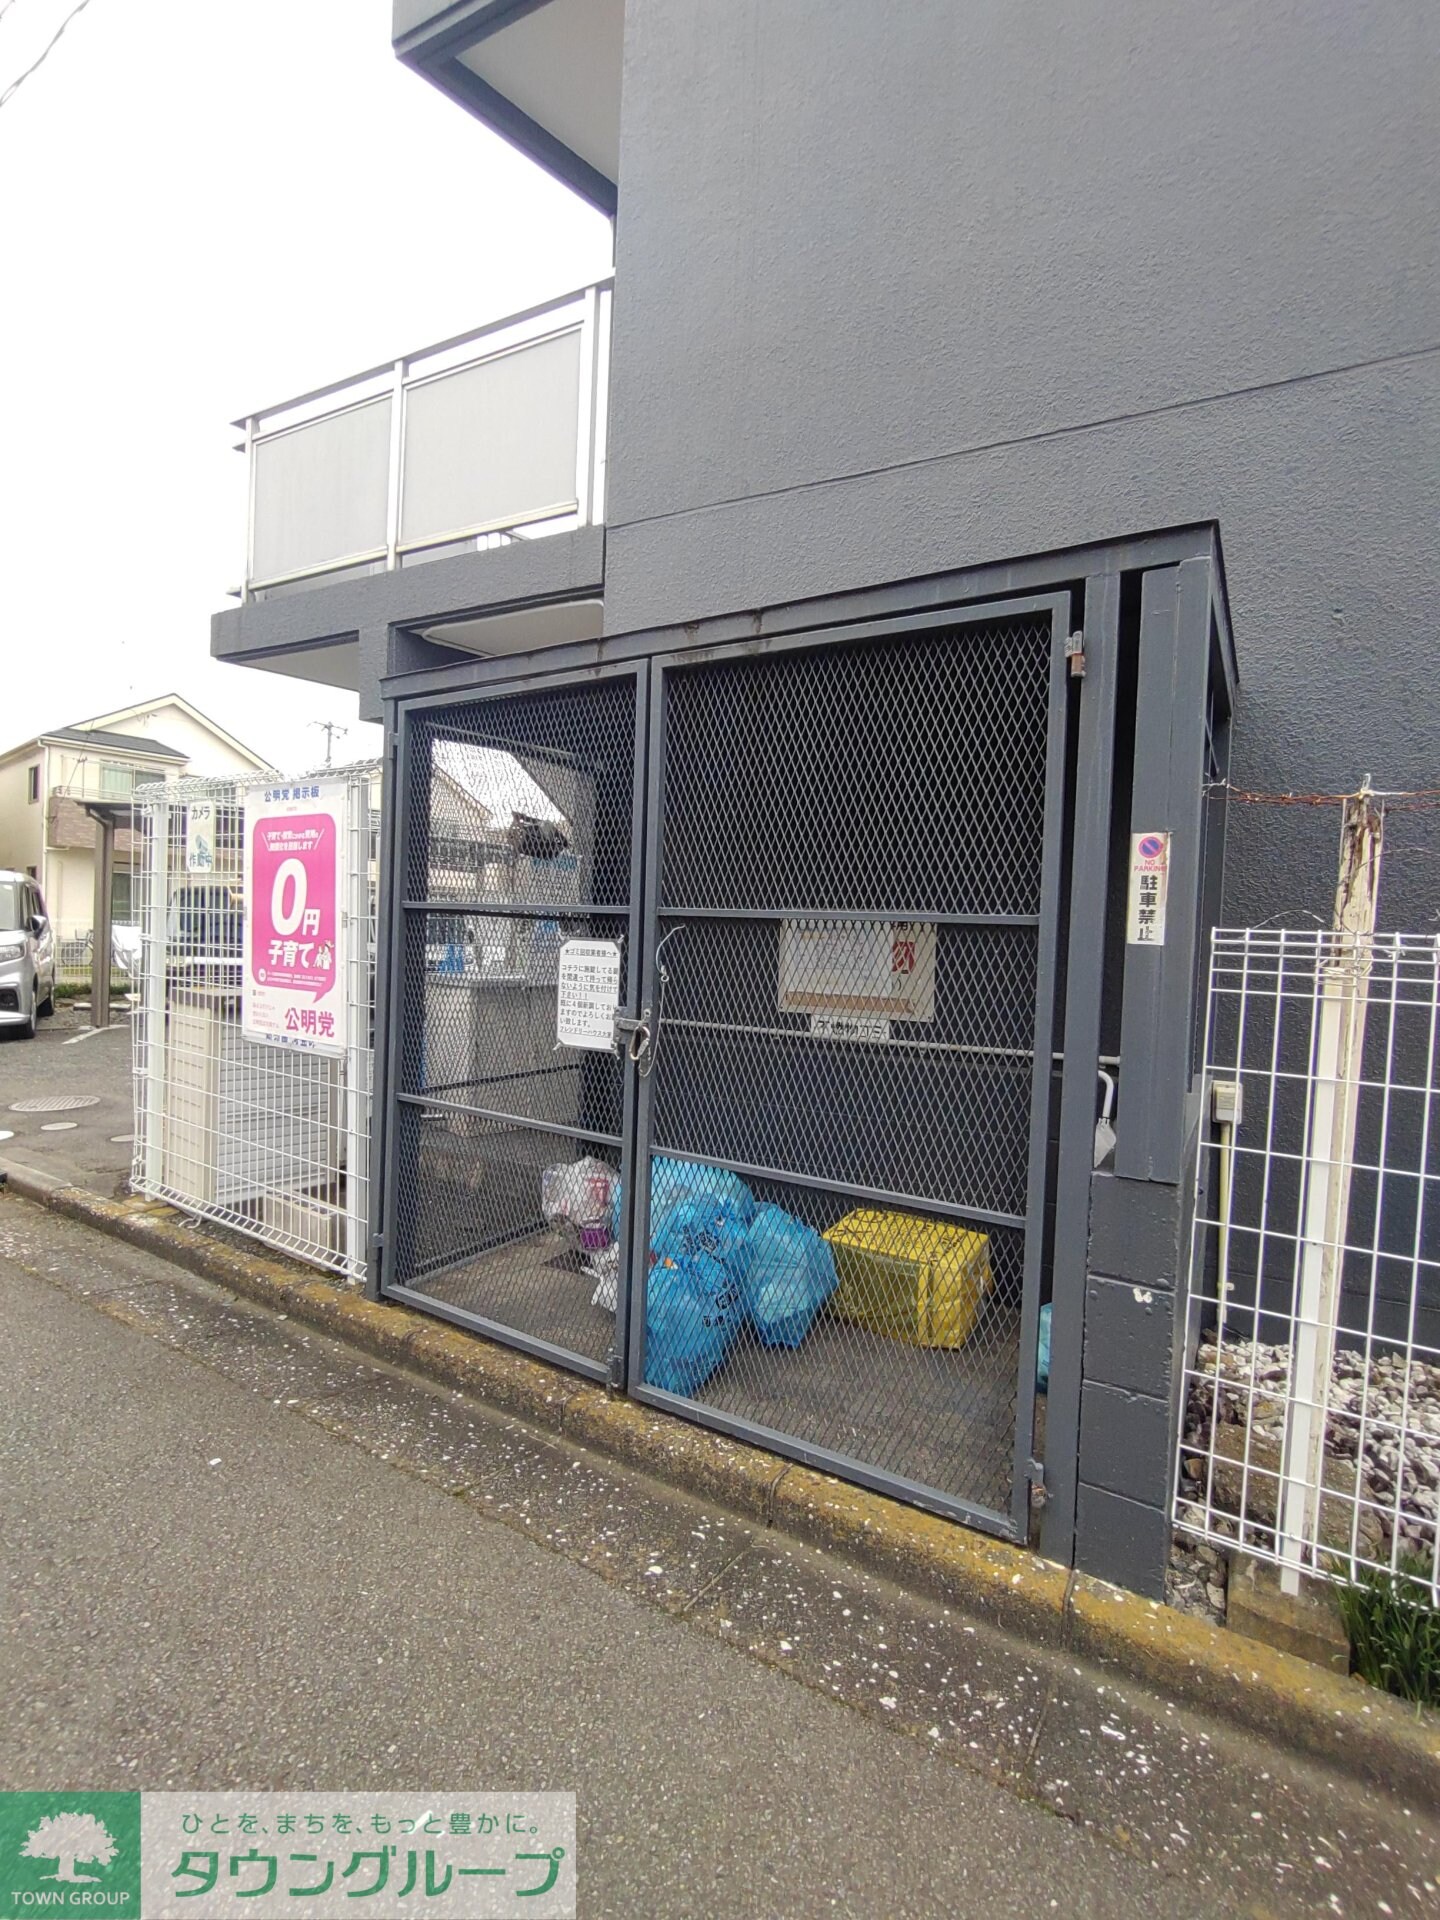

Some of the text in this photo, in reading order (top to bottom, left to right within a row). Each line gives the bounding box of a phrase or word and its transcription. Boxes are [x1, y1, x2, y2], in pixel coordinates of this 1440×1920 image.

[264, 785, 320, 802] 公明党 掲示板
[191, 805, 211, 820] カメラ
[1134, 865, 1167, 873] PARKING
[271, 857, 321, 936] 0円
[1137, 874, 1158, 942] 駐車禁止
[268, 939, 314, 970] 子育て
[560, 982, 618, 993] ないように気を付けて
[284, 1007, 335, 1038] 公明党
[560, 1008, 612, 1020] ますのでよろしくお
